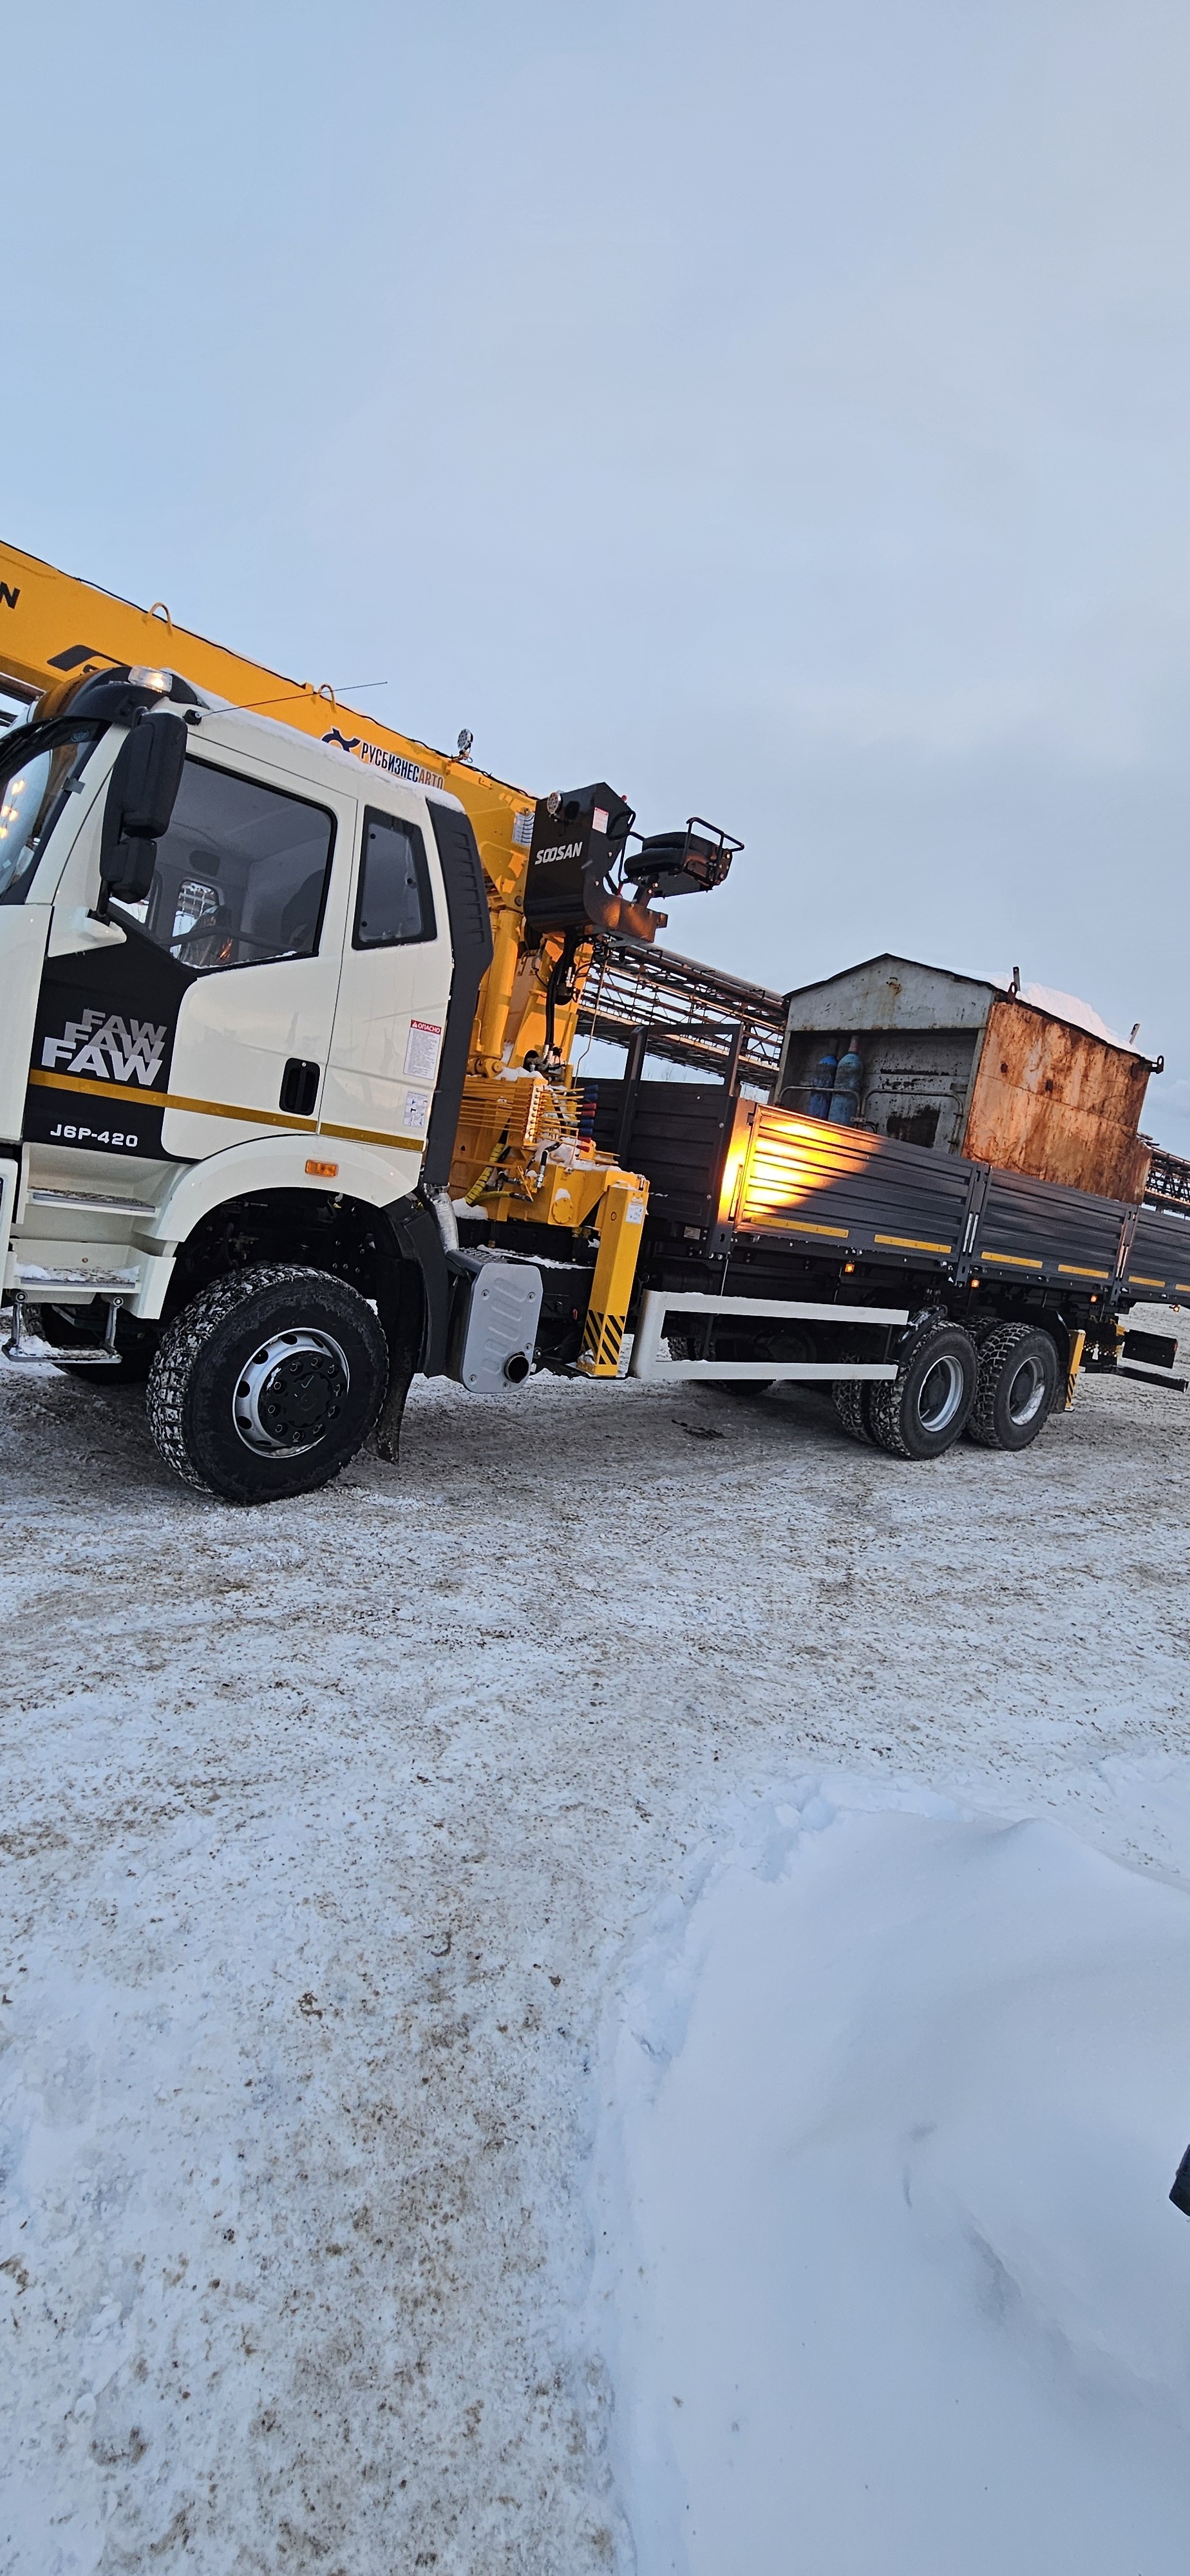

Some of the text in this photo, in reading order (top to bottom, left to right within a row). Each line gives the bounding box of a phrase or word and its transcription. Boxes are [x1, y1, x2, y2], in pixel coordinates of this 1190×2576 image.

[361, 742, 444, 790] РУСБИЗНЕСАВТО
[534, 841, 583, 865] SOOSAN
[64, 1021, 165, 1063] FAW
[82, 1009, 167, 1045] FAW
[418, 1023, 440, 1034] ОПАСНО
[41, 1036, 162, 1086] FAW
[50, 1124, 138, 1148] J6P-420
